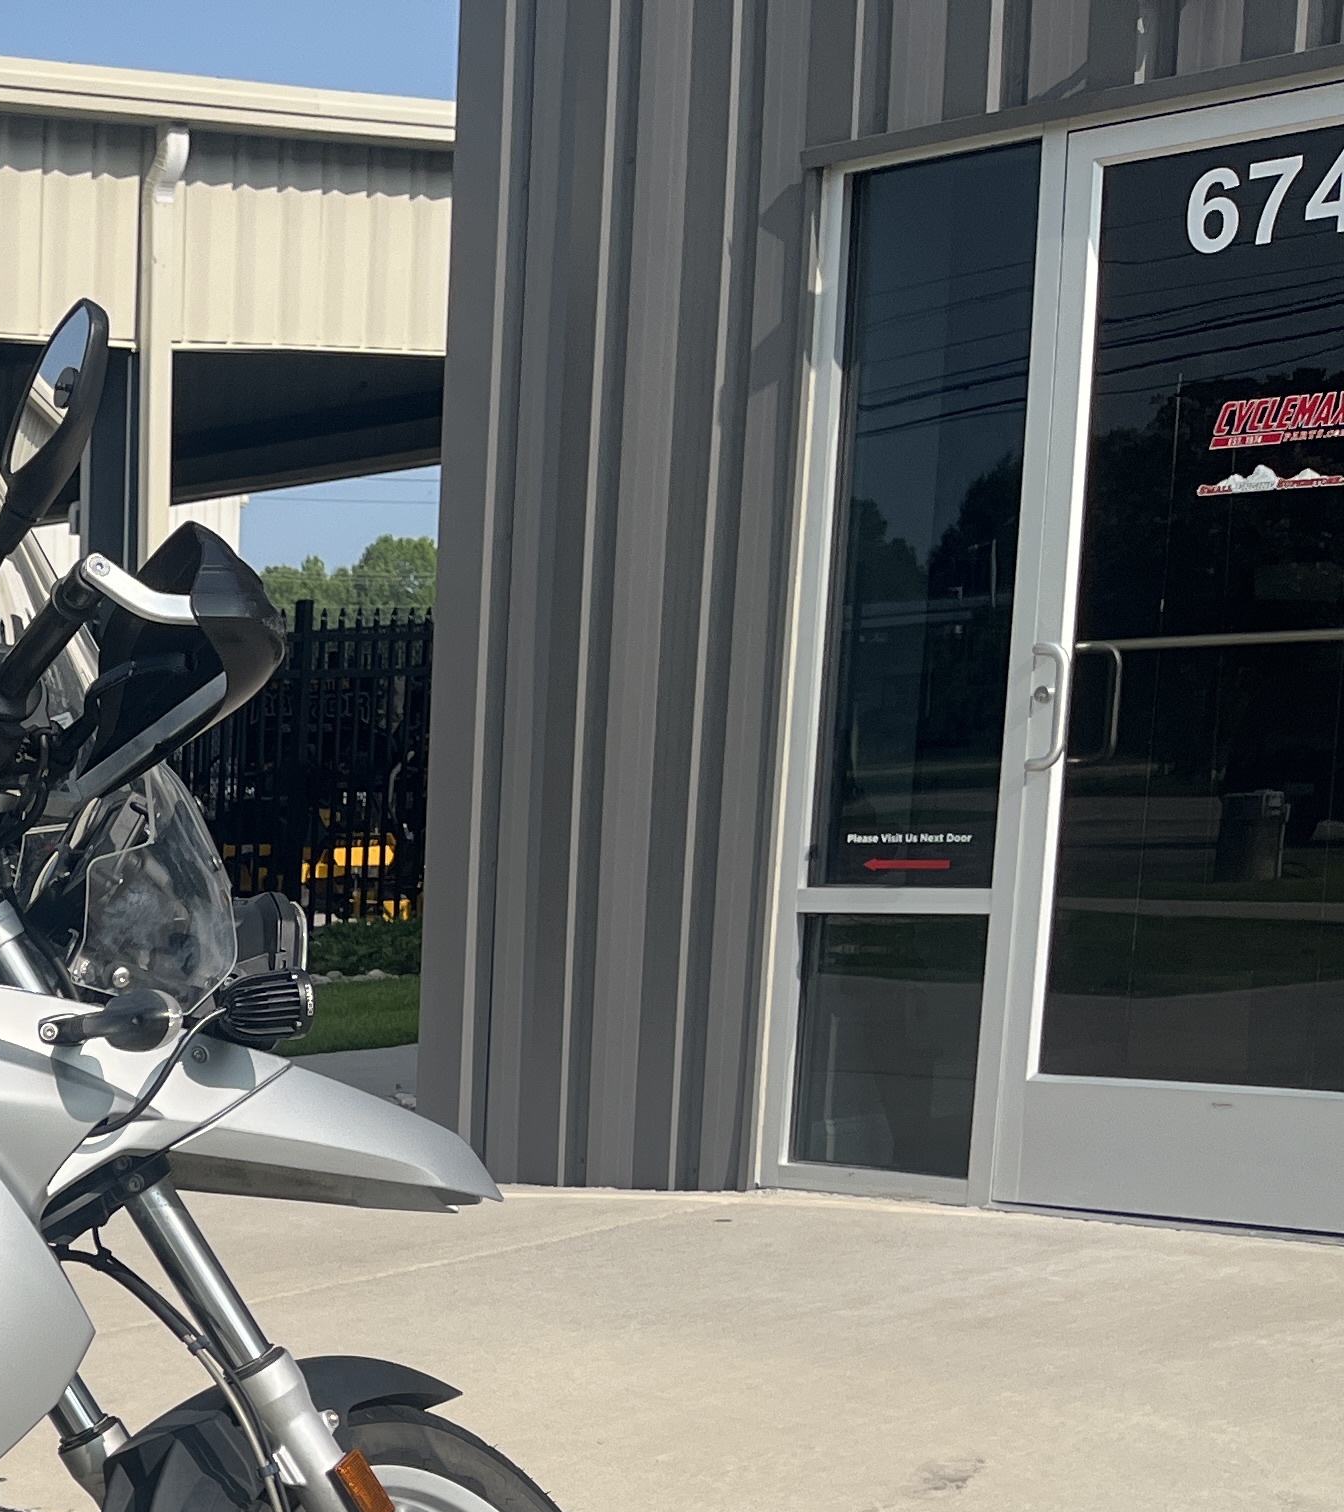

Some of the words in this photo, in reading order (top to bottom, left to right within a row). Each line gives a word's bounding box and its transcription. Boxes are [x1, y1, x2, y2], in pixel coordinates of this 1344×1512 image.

[1187, 149, 1344, 254] 674
[847, 833, 879, 843] Please
[880, 833, 903, 843] Visit
[905, 833, 918, 843] Us
[920, 833, 944, 843] Next
[946, 832, 972, 843] Door
